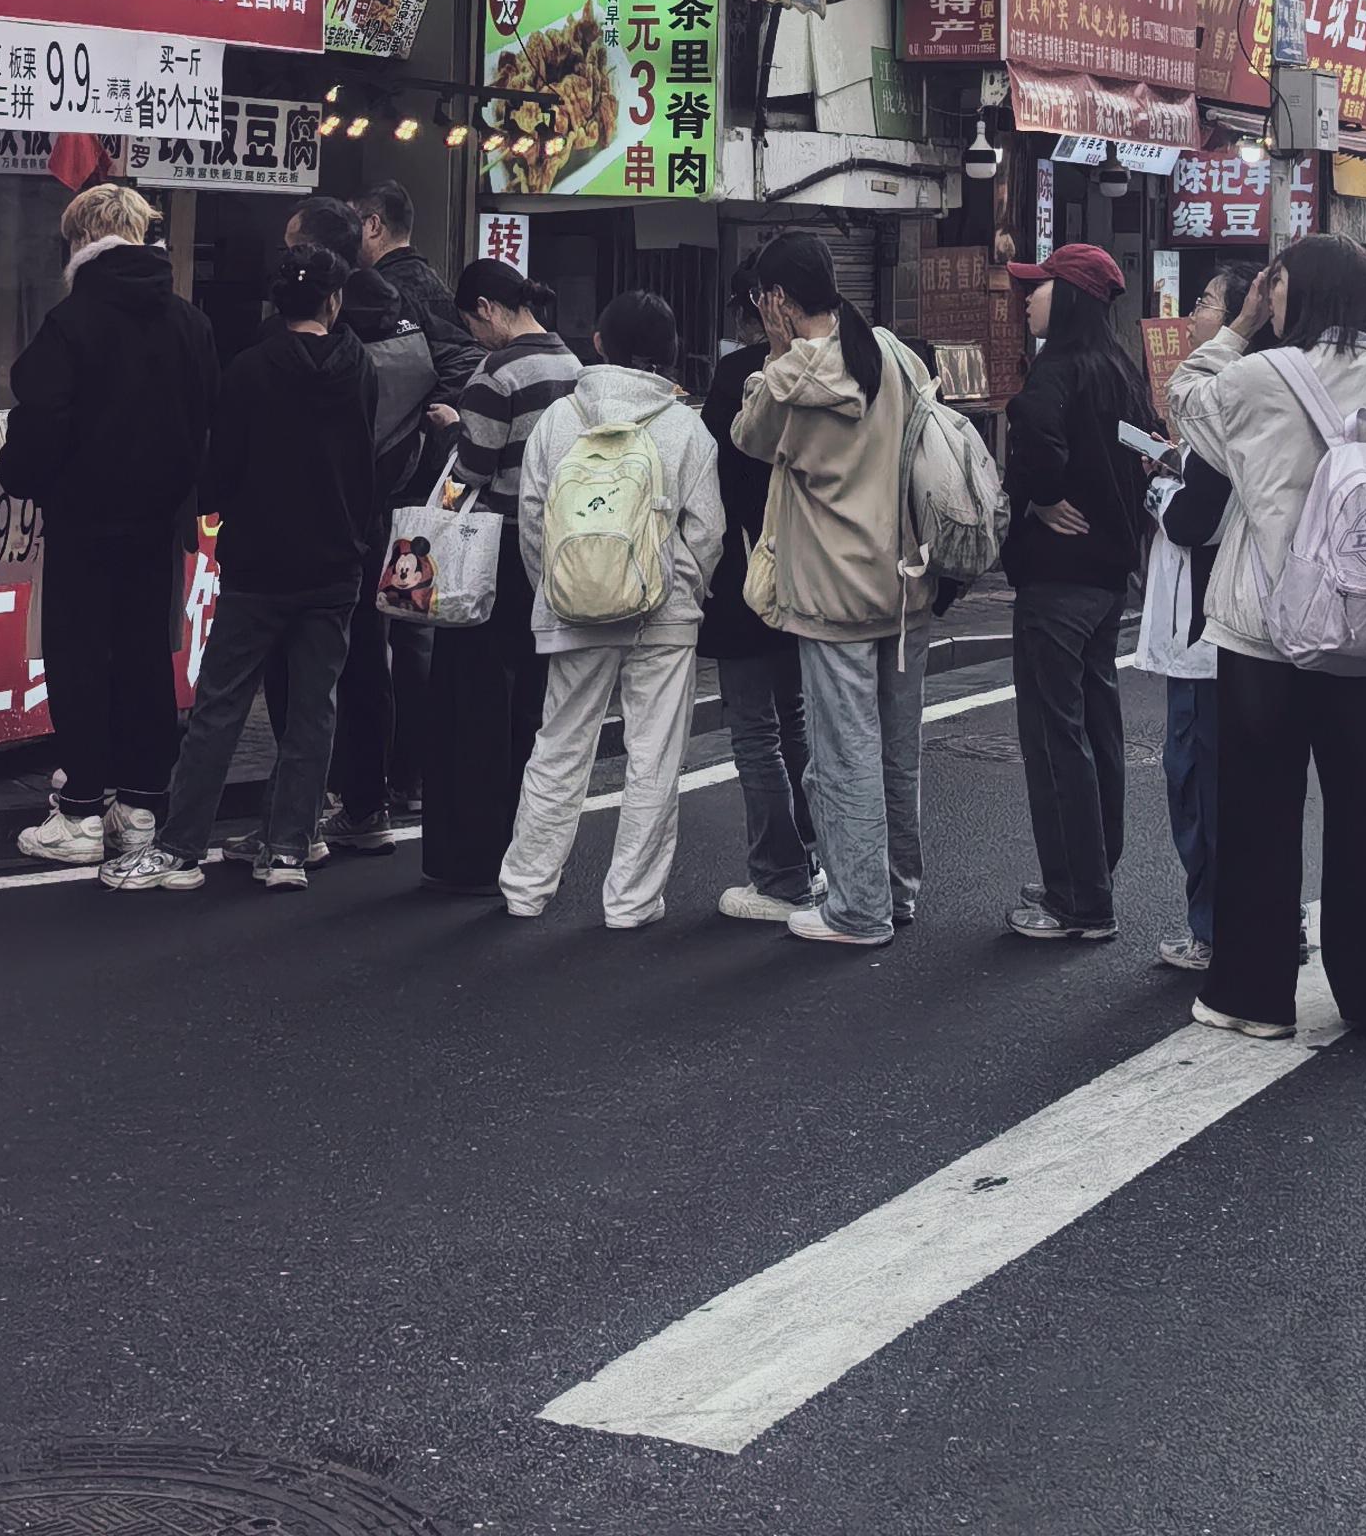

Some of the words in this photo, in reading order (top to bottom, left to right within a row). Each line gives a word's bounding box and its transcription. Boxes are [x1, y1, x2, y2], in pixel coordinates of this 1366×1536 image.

[9, 46, 36, 80] 板栗
[159, 45, 201, 76] 买一斤
[106, 77, 131, 101] 满满
[105, 102, 133, 124] 一大盒
[135, 81, 220, 134] 省5个大洋
[1147, 326, 1180, 357] 租房
